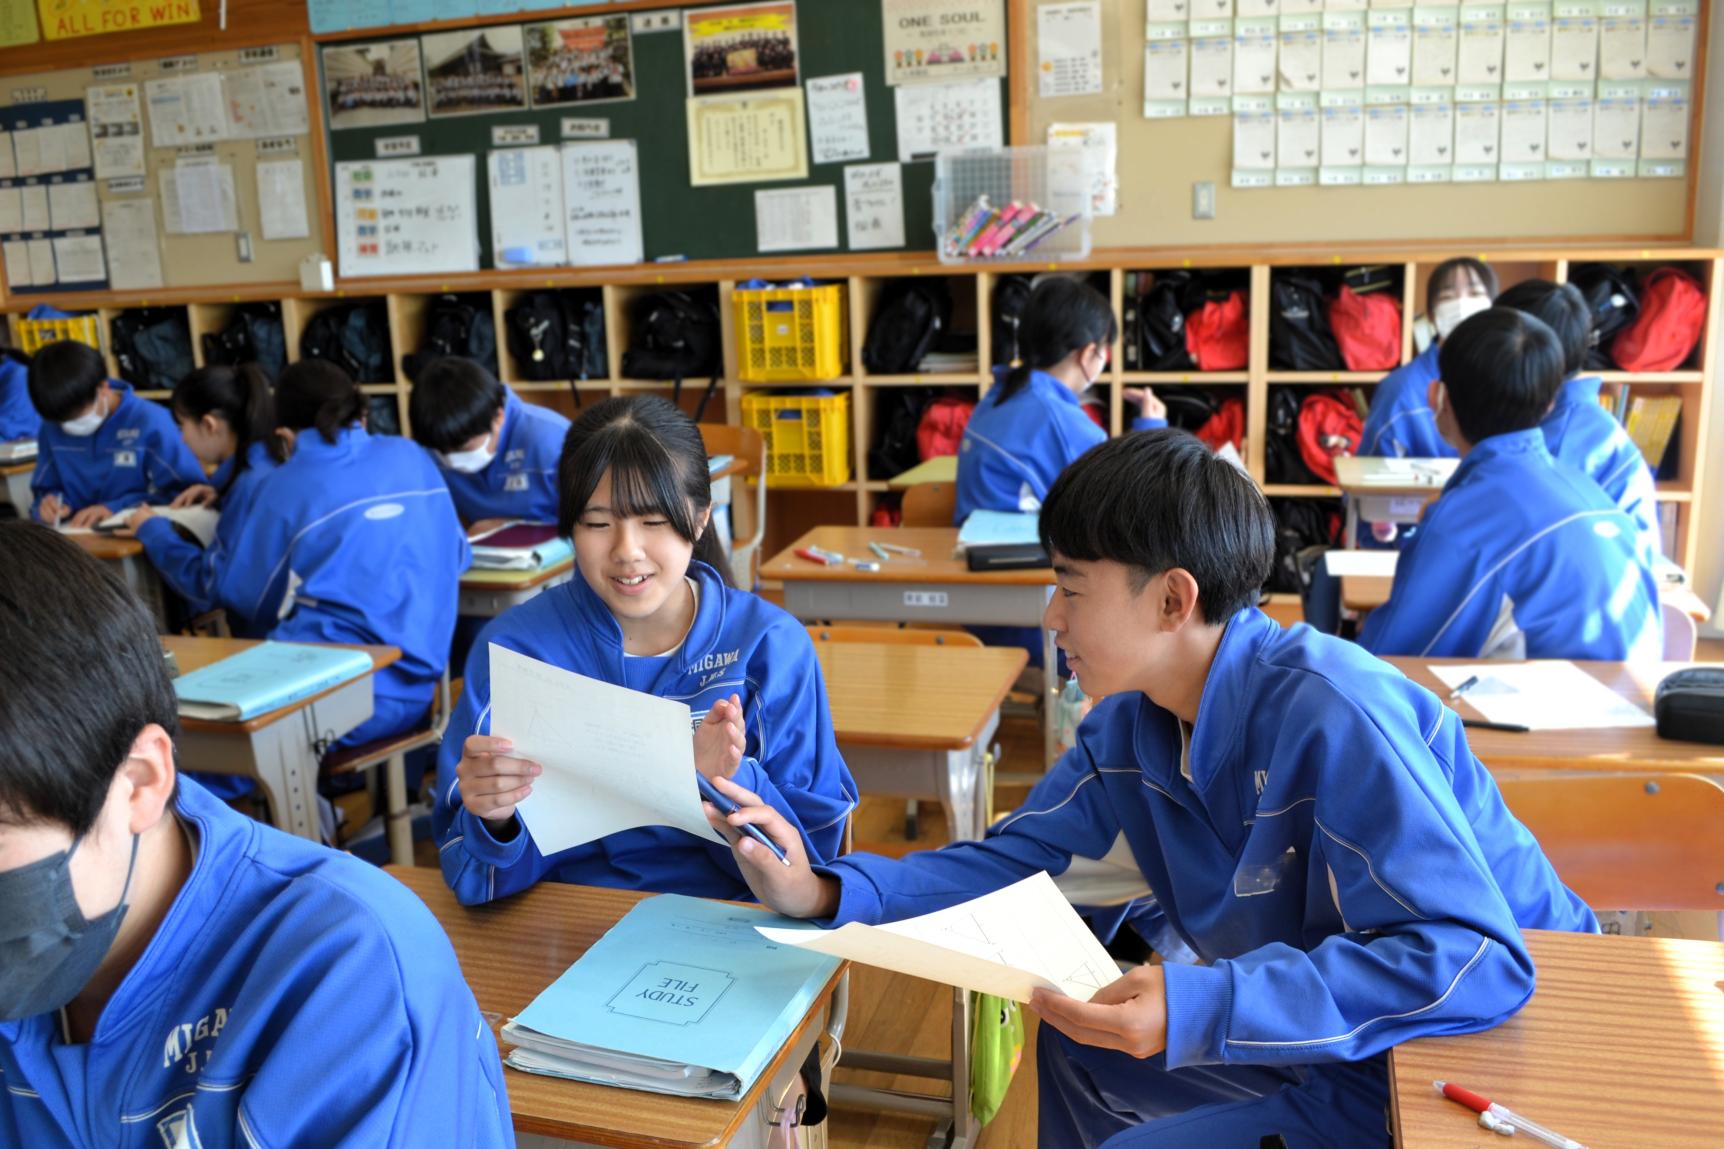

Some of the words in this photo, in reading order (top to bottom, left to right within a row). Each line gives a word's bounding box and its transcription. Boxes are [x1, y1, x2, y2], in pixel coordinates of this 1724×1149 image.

[56, 14, 96, 36] ALL
[101, 7, 141, 29] FOR
[150, 2, 191, 22] WIN
[898, 15, 932, 29] ONE
[939, 11, 986, 25] SOUL
[657, 977, 700, 993] FILE
[635, 988, 700, 1007] STUDY
[163, 1007, 232, 1069] MIGA
